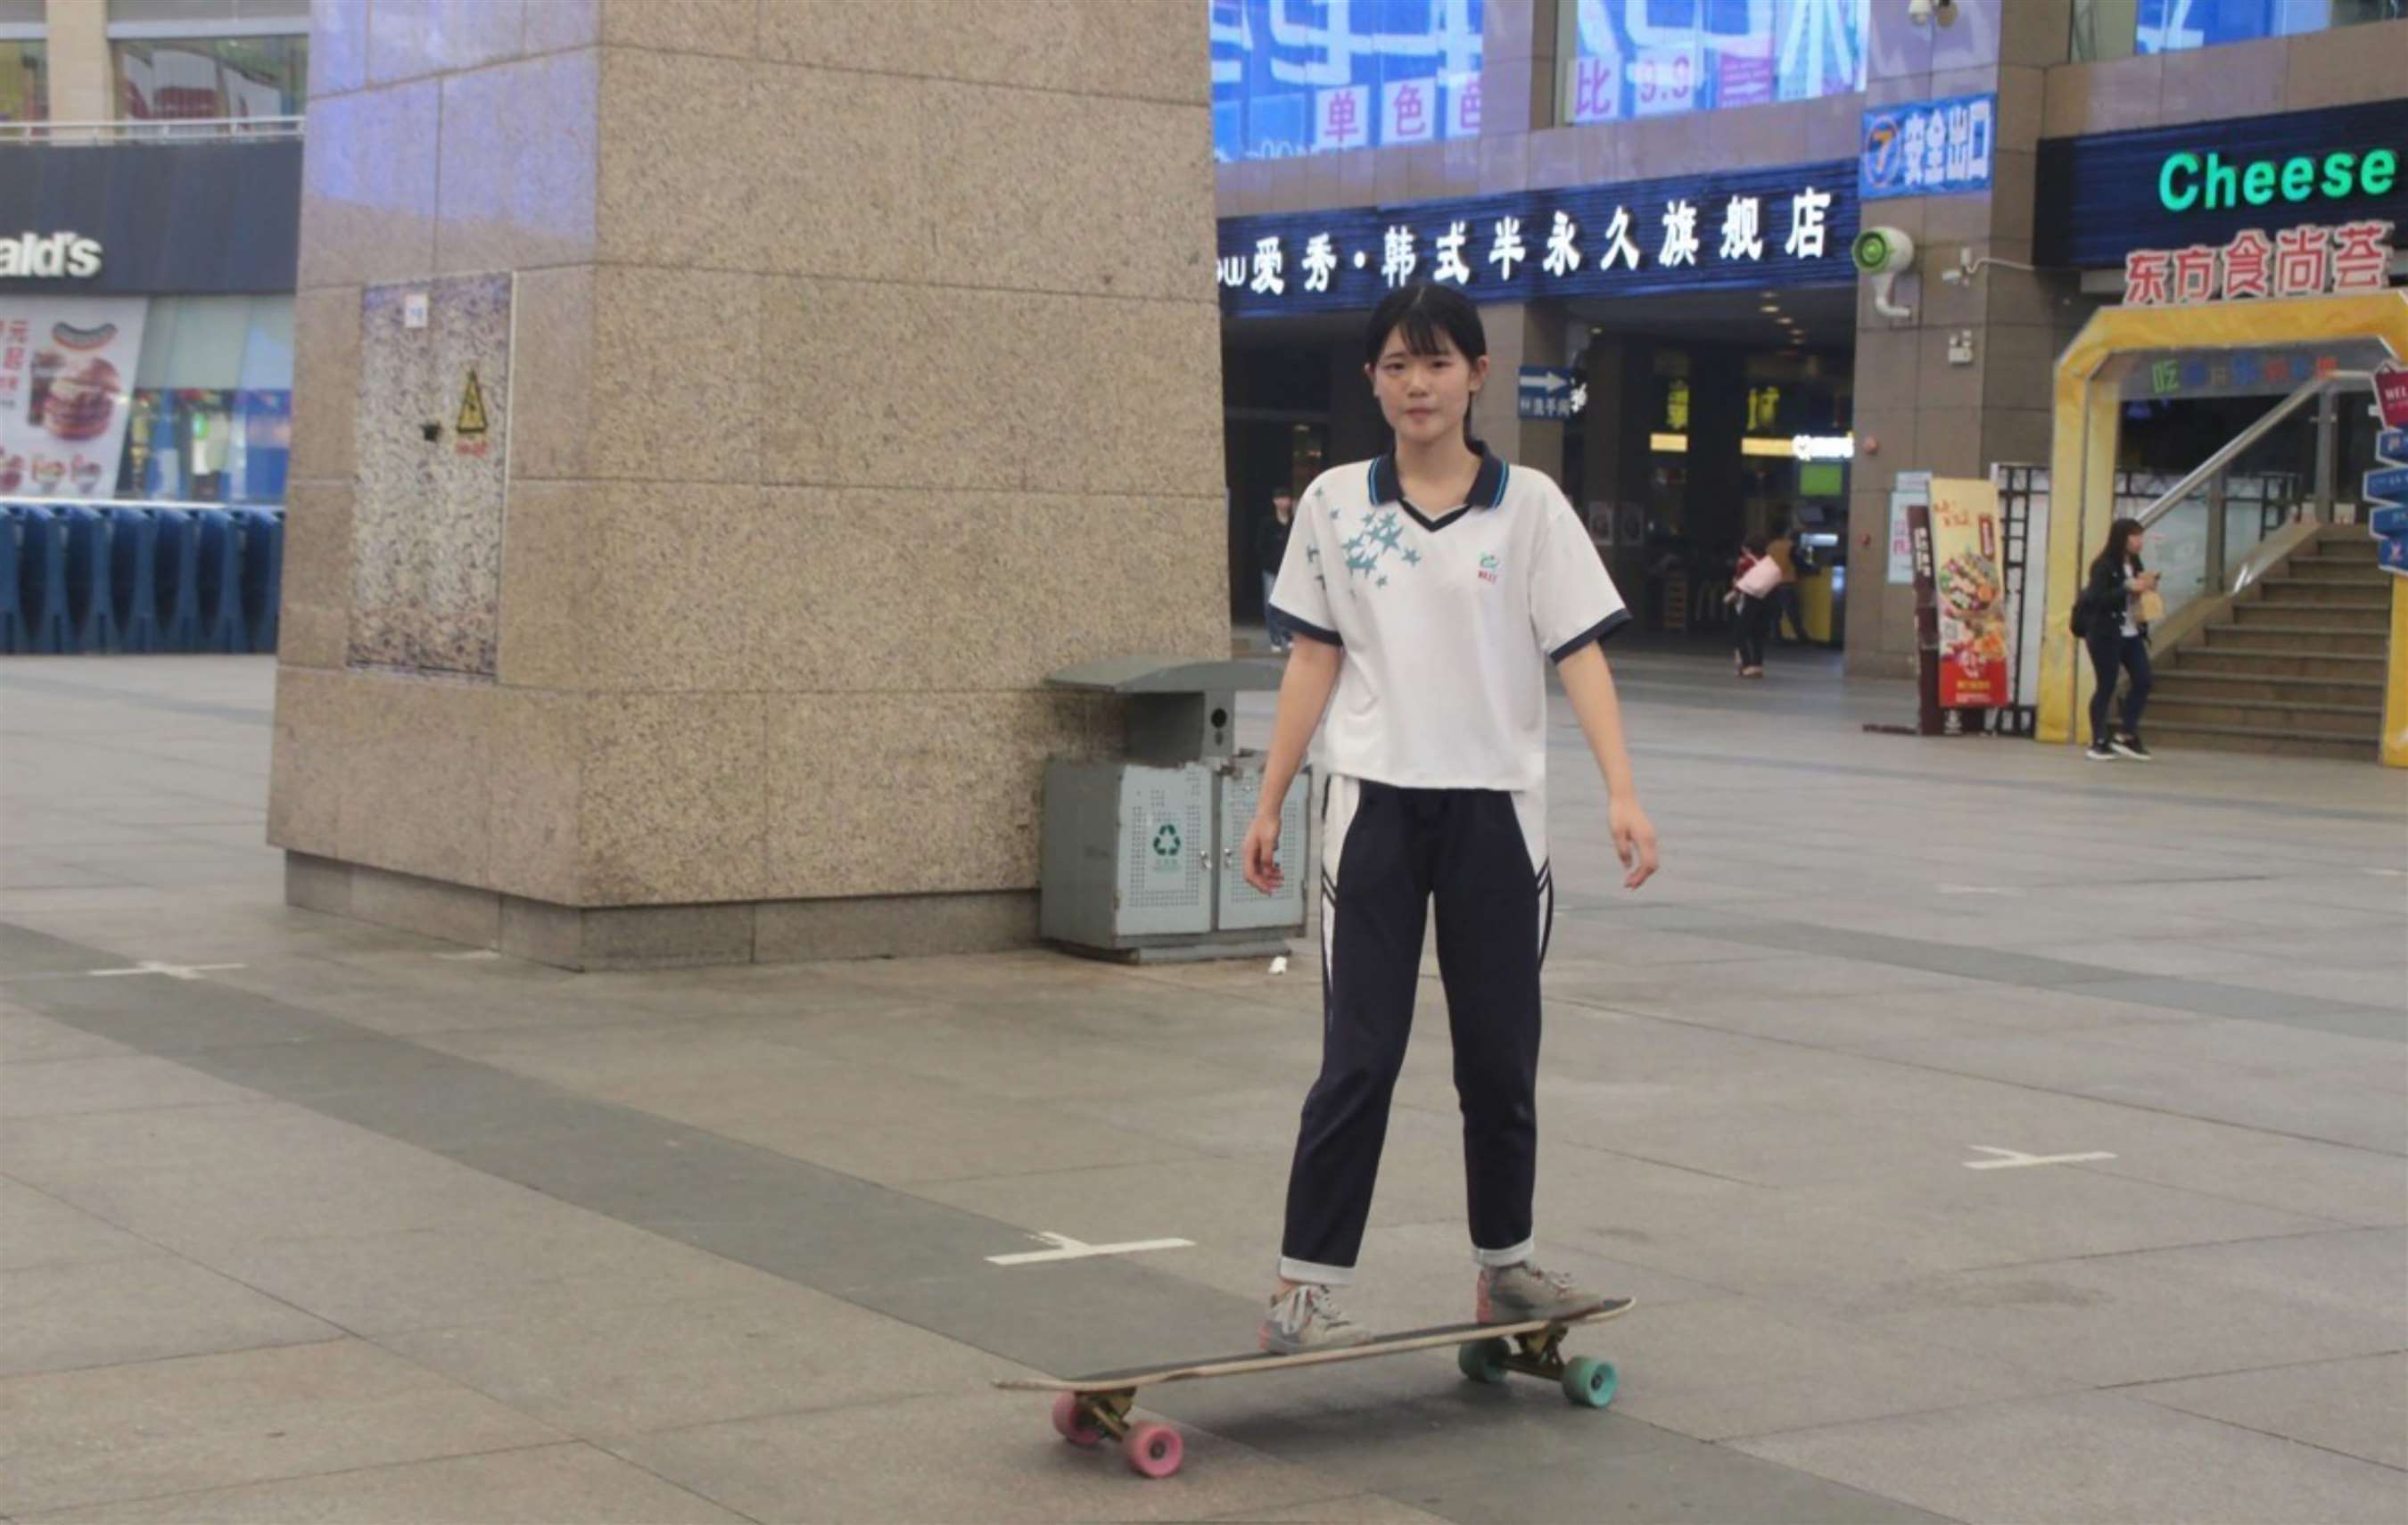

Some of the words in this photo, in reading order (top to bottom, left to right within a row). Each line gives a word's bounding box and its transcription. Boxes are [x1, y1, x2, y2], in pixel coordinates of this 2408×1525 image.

[1903, 100, 1992, 186] 安全出口
[2158, 148, 2396, 212] Cheese
[2126, 221, 2391, 304] 东方食尚荟
